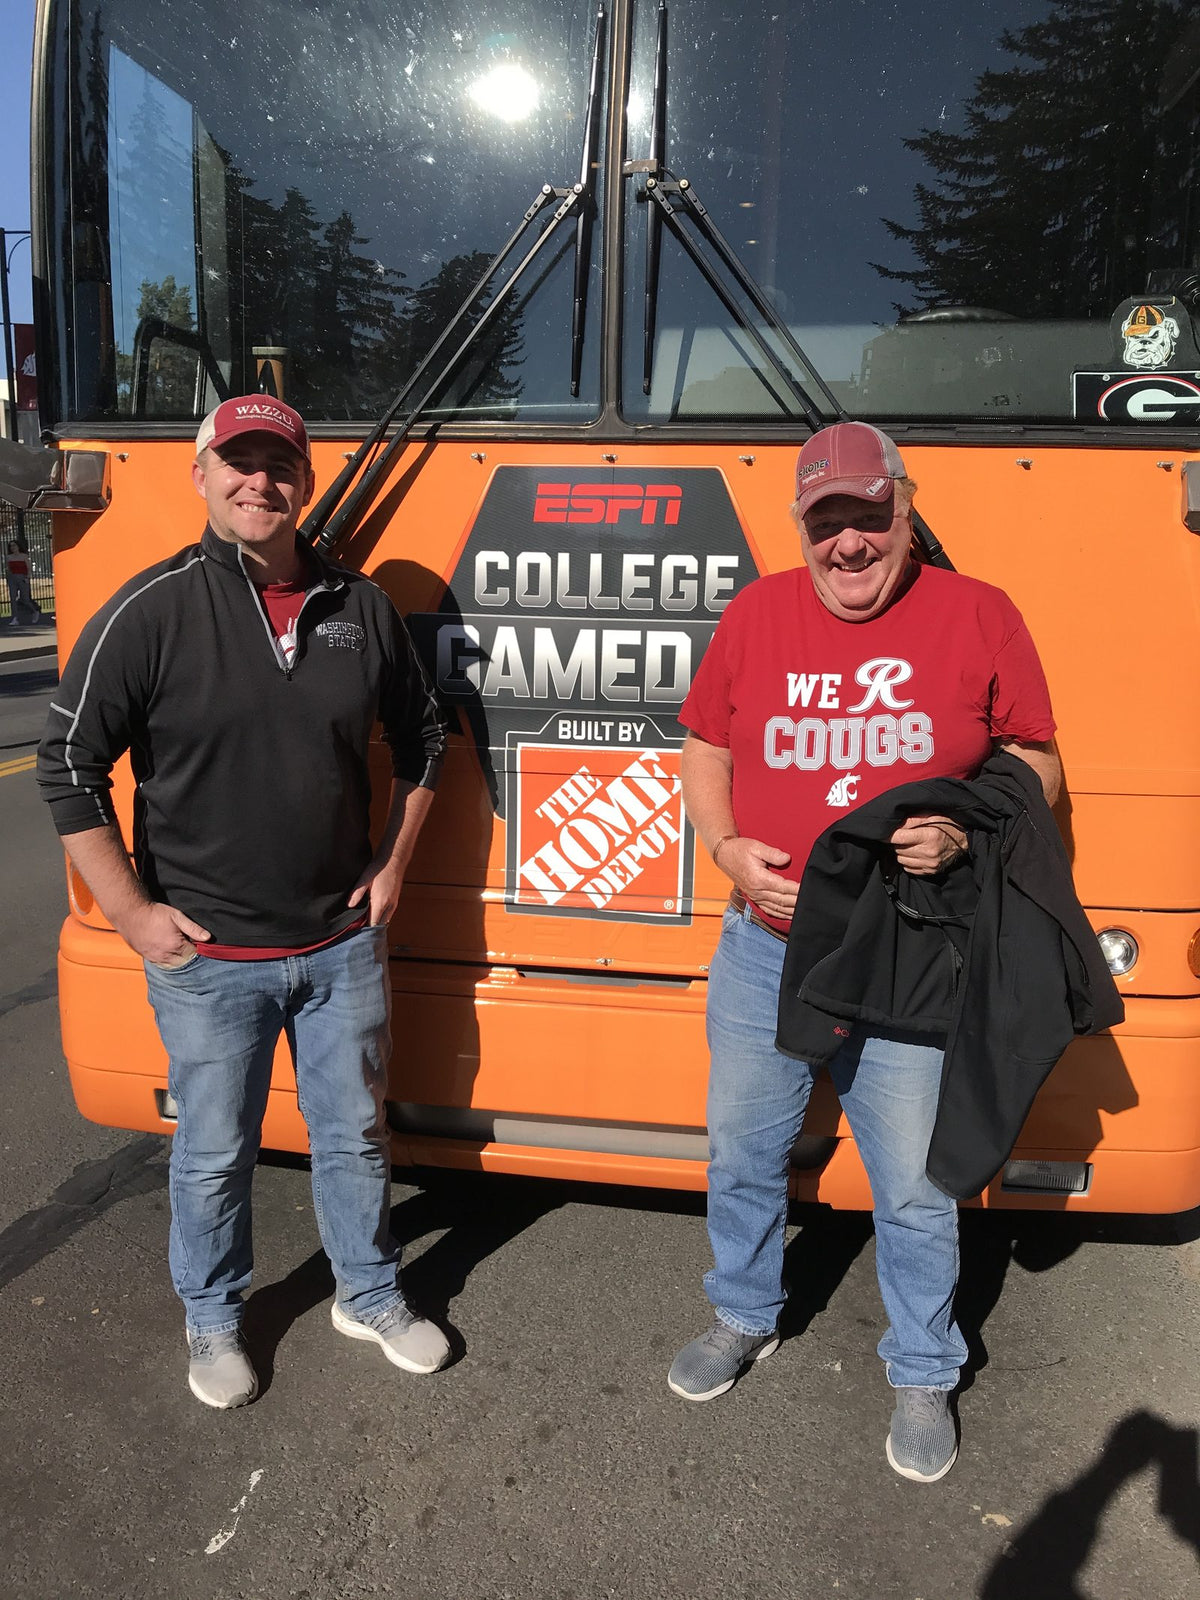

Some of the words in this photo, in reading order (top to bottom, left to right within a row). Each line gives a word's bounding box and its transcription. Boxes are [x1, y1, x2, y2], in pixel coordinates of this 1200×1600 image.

[533, 483, 683, 525] ESPN
[474, 550, 739, 612] COLLEGE
[436, 624, 715, 704] GAMED
[786, 672, 842, 709] WE
[846, 656, 914, 714] R
[558, 719, 614, 742] BUILT
[618, 721, 646, 742] BY
[763, 711, 935, 771] COUGS
[520, 750, 682, 905] HOME
[534, 765, 603, 828] THE
[580, 810, 681, 909] DEPOT
